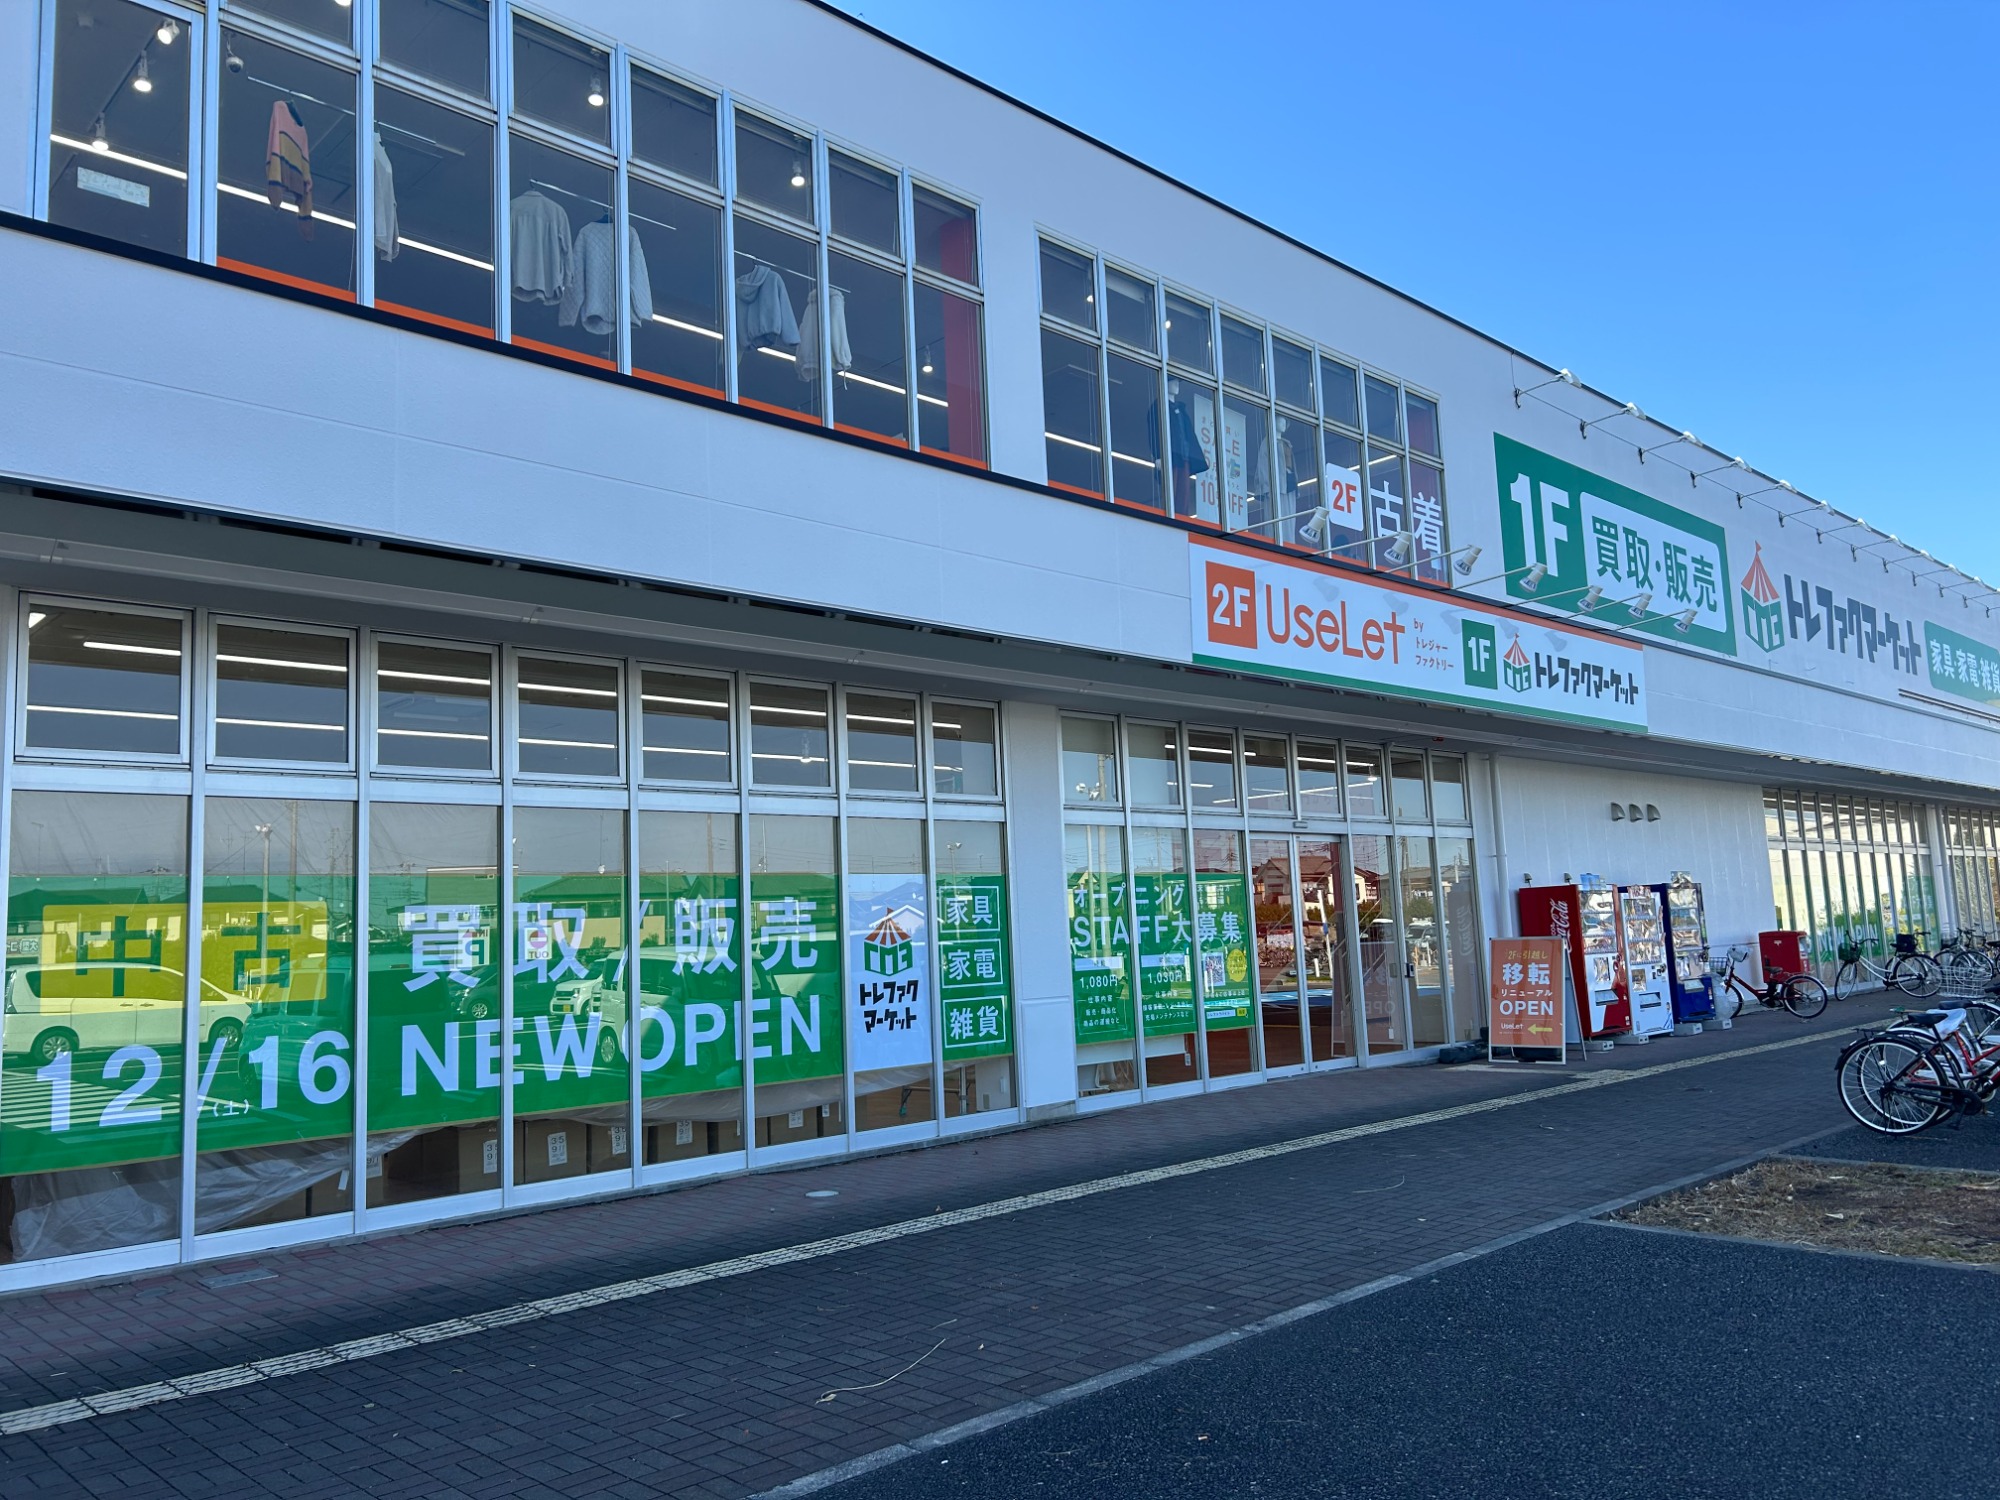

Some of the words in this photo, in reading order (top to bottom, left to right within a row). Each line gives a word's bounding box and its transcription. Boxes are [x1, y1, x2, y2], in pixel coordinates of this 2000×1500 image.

[1332, 480, 1357, 514] 2F
[1370, 480, 1443, 555] 古着
[1510, 473, 1569, 577] 1F
[1591, 516, 1717, 613] 買取・販売
[1213, 583, 1251, 628] 2F
[1265, 583, 1406, 664] UseLet
[1413, 618, 1424, 633] by
[1784, 573, 1922, 676] トレファクマーケット
[1415, 637, 1448, 652] トレジャー
[1467, 636, 1491, 673] 1F
[1415, 655, 1454, 671] ファクトリー
[1535, 652, 1639, 705] トレファクマーケット
[946, 895, 993, 925] 家具
[1074, 881, 1186, 908] オープニング
[1073, 911, 1242, 948] STAFF大募集
[76, 912, 302, 996] 中古
[948, 948, 996, 981] 家電
[1079, 973, 1118, 990] 1,080円
[1502, 962, 1550, 985] 移転
[860, 980, 919, 1006] トレファク
[1499, 1000, 1554, 1016] OPEN
[1501, 988, 1553, 997] リニューアル
[863, 1007, 917, 1033] マーケット
[950, 1005, 999, 1040] 雑貨
[401, 1012, 601, 1096] NEW
[623, 995, 821, 1072] OPEN
[37, 1031, 351, 1132] 12/16
